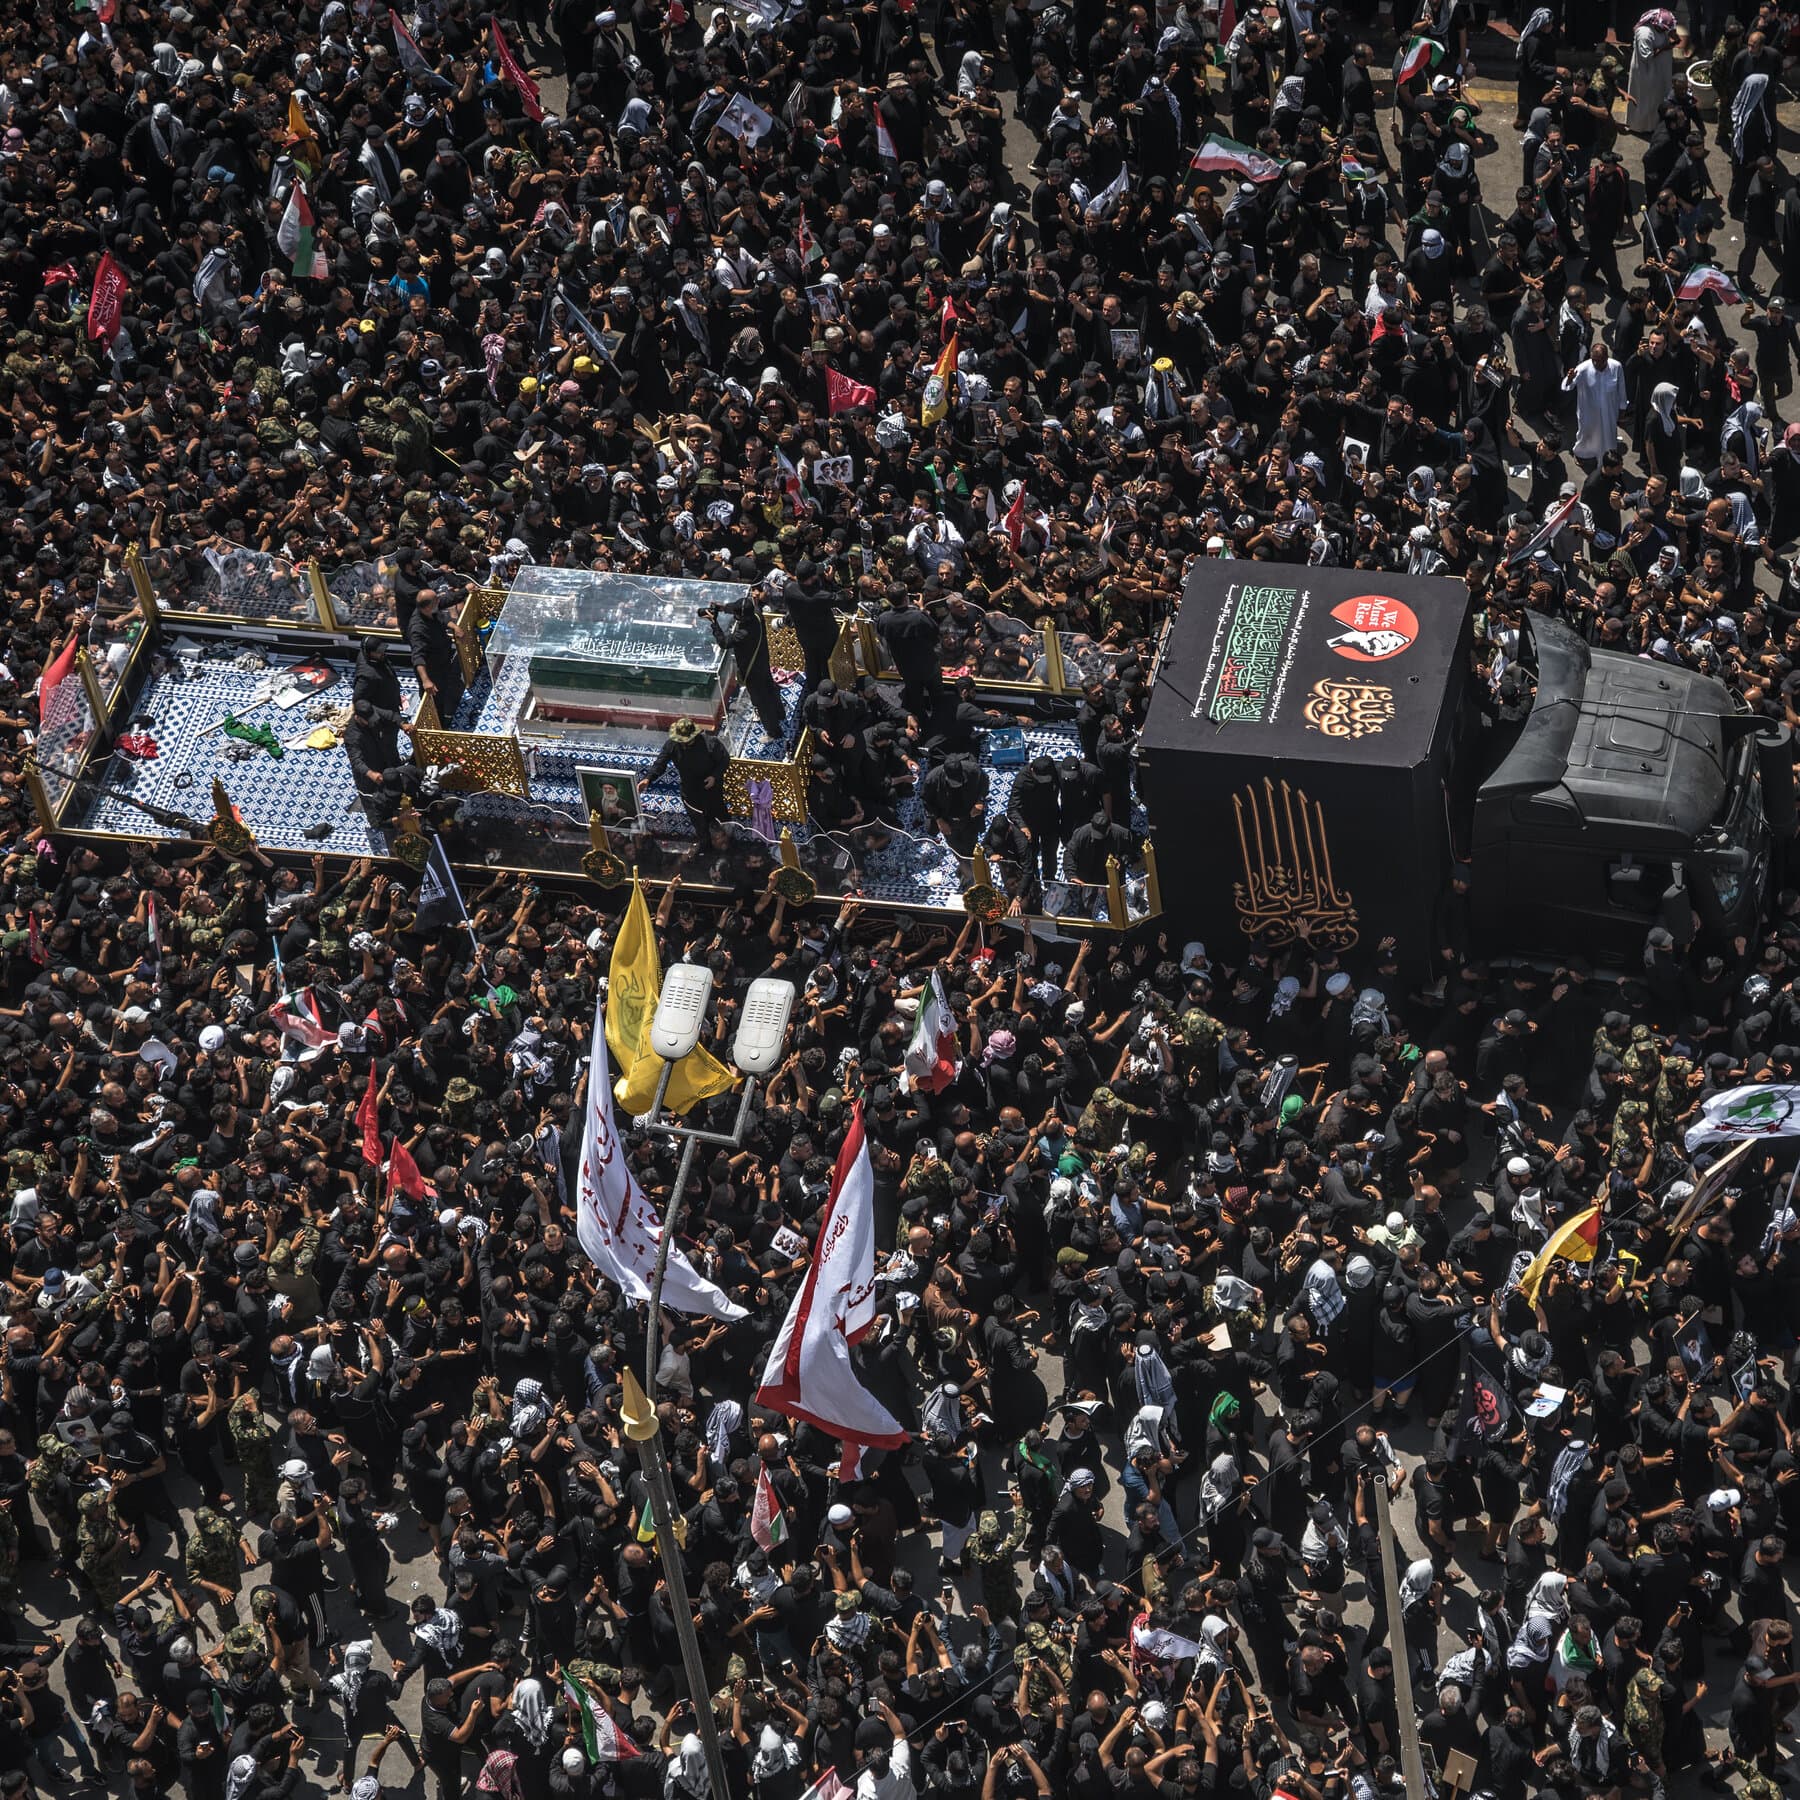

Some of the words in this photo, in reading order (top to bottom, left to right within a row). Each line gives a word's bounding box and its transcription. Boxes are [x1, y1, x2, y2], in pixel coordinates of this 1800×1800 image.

[1353, 601, 1372, 626] Rise
[1368, 598, 1389, 627] Must
[1380, 608, 1398, 628] We
